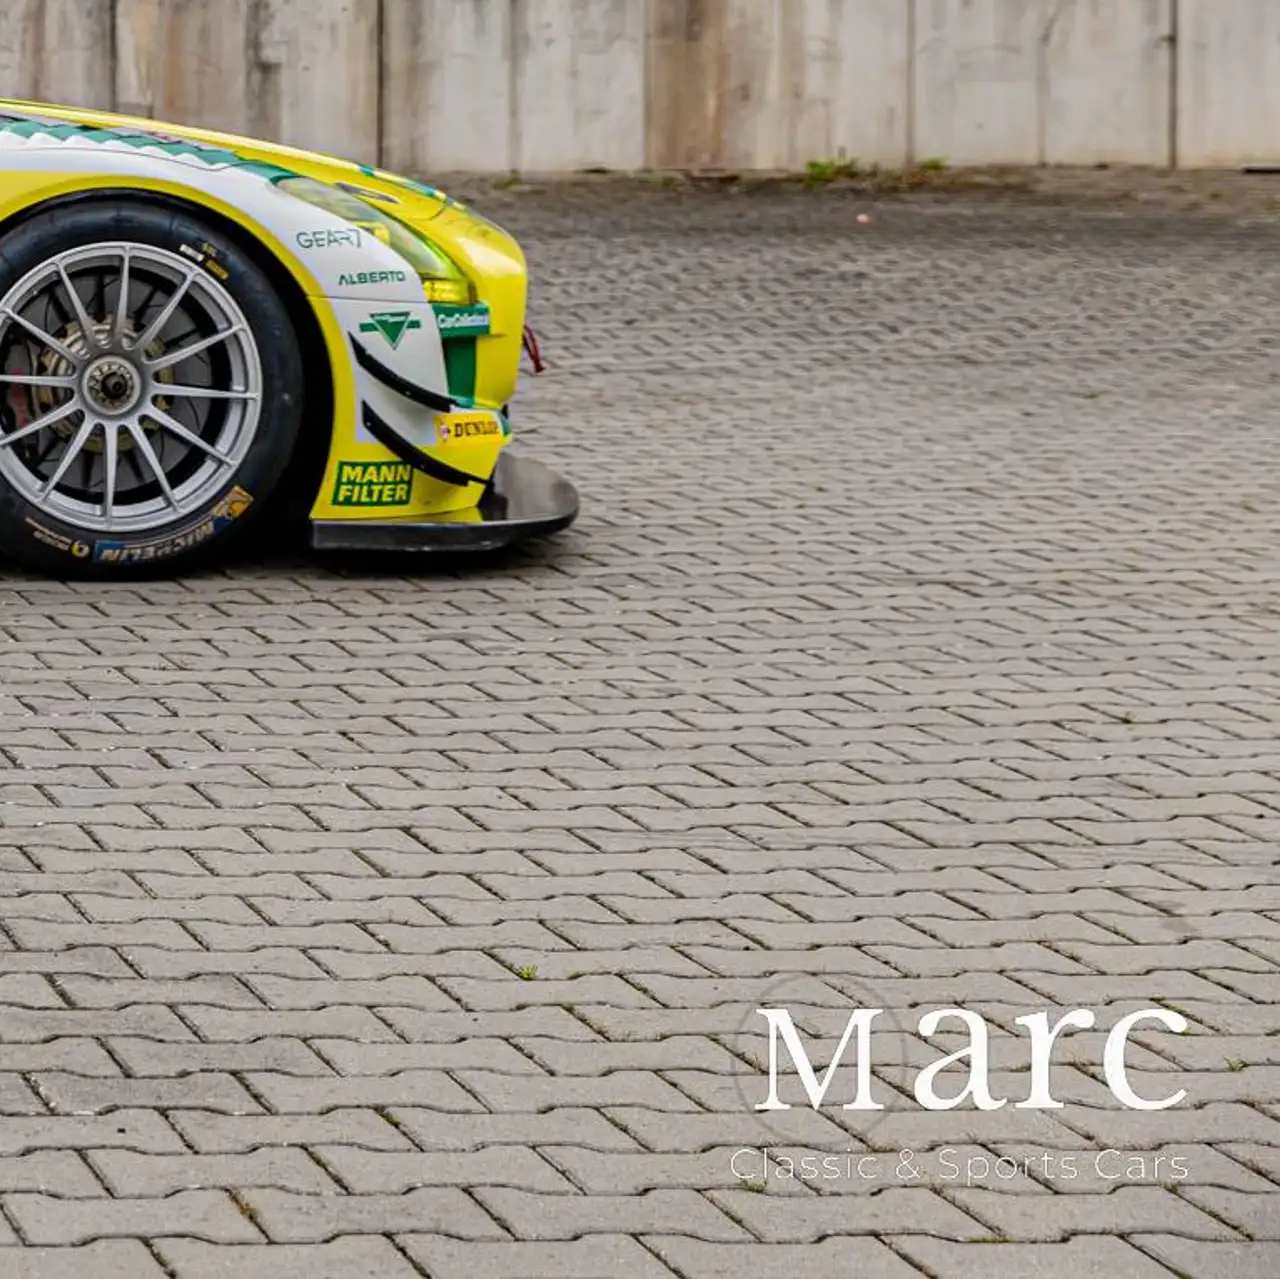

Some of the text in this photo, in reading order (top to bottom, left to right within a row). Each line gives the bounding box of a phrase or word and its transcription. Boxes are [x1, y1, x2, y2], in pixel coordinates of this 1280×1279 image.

[338, 270, 406, 286] ALBERTO
[342, 465, 411, 483] MANN
[339, 484, 408, 502] FILTER
